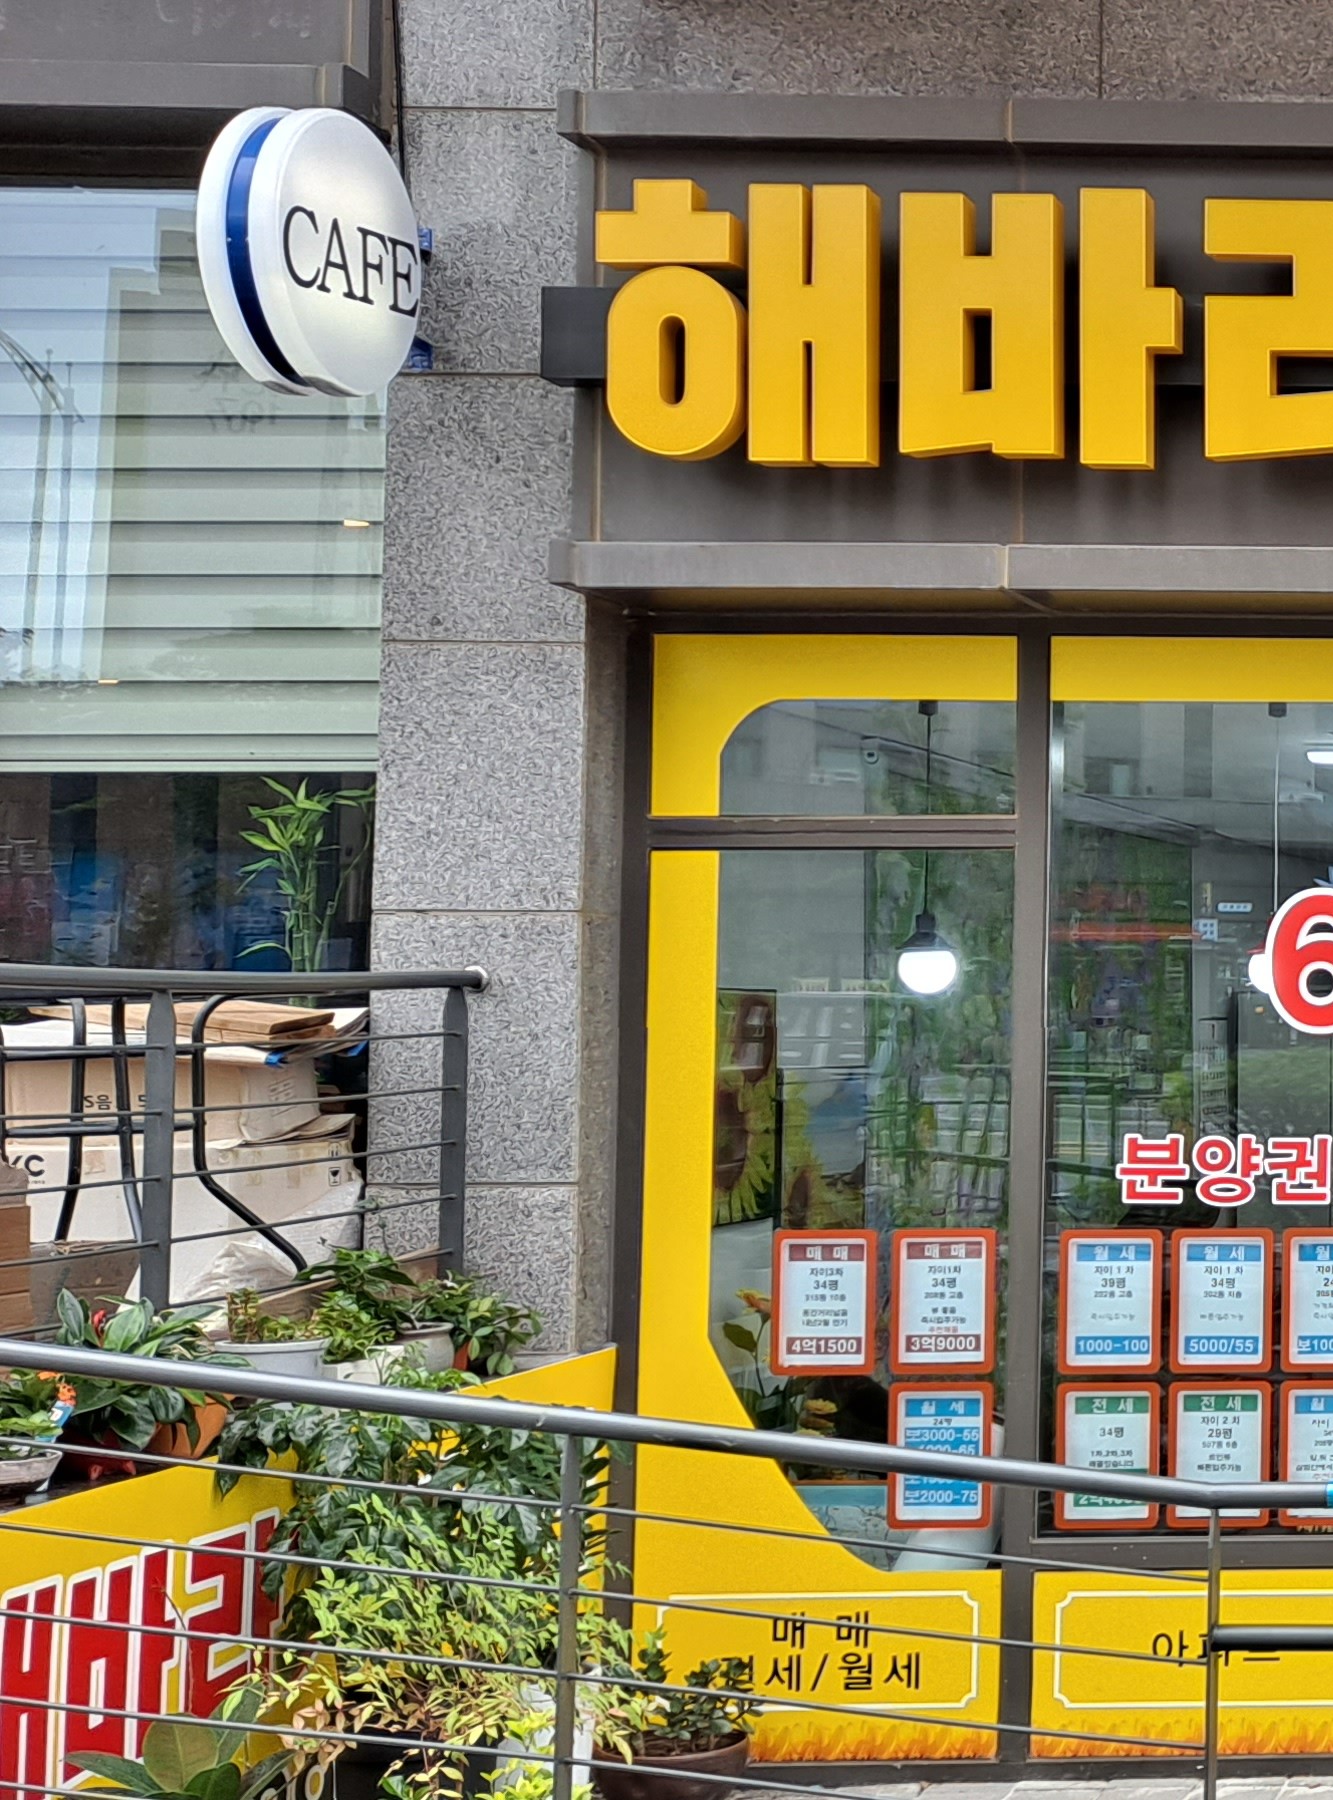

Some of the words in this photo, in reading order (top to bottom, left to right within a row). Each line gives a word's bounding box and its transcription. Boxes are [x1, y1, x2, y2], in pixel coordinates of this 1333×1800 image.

[283, 205, 418, 318] CAFE
[1116, 1133, 1333, 1206] 분양권
[813, 1279, 839, 1291] 34평
[931, 1277, 957, 1289] 34평
[792, 1338, 857, 1354] 4억1500
[911, 1336, 976, 1352] 3억9000
[1078, 1339, 1149, 1352] 1000-100
[1189, 1338, 1254, 1353] 5000/55
